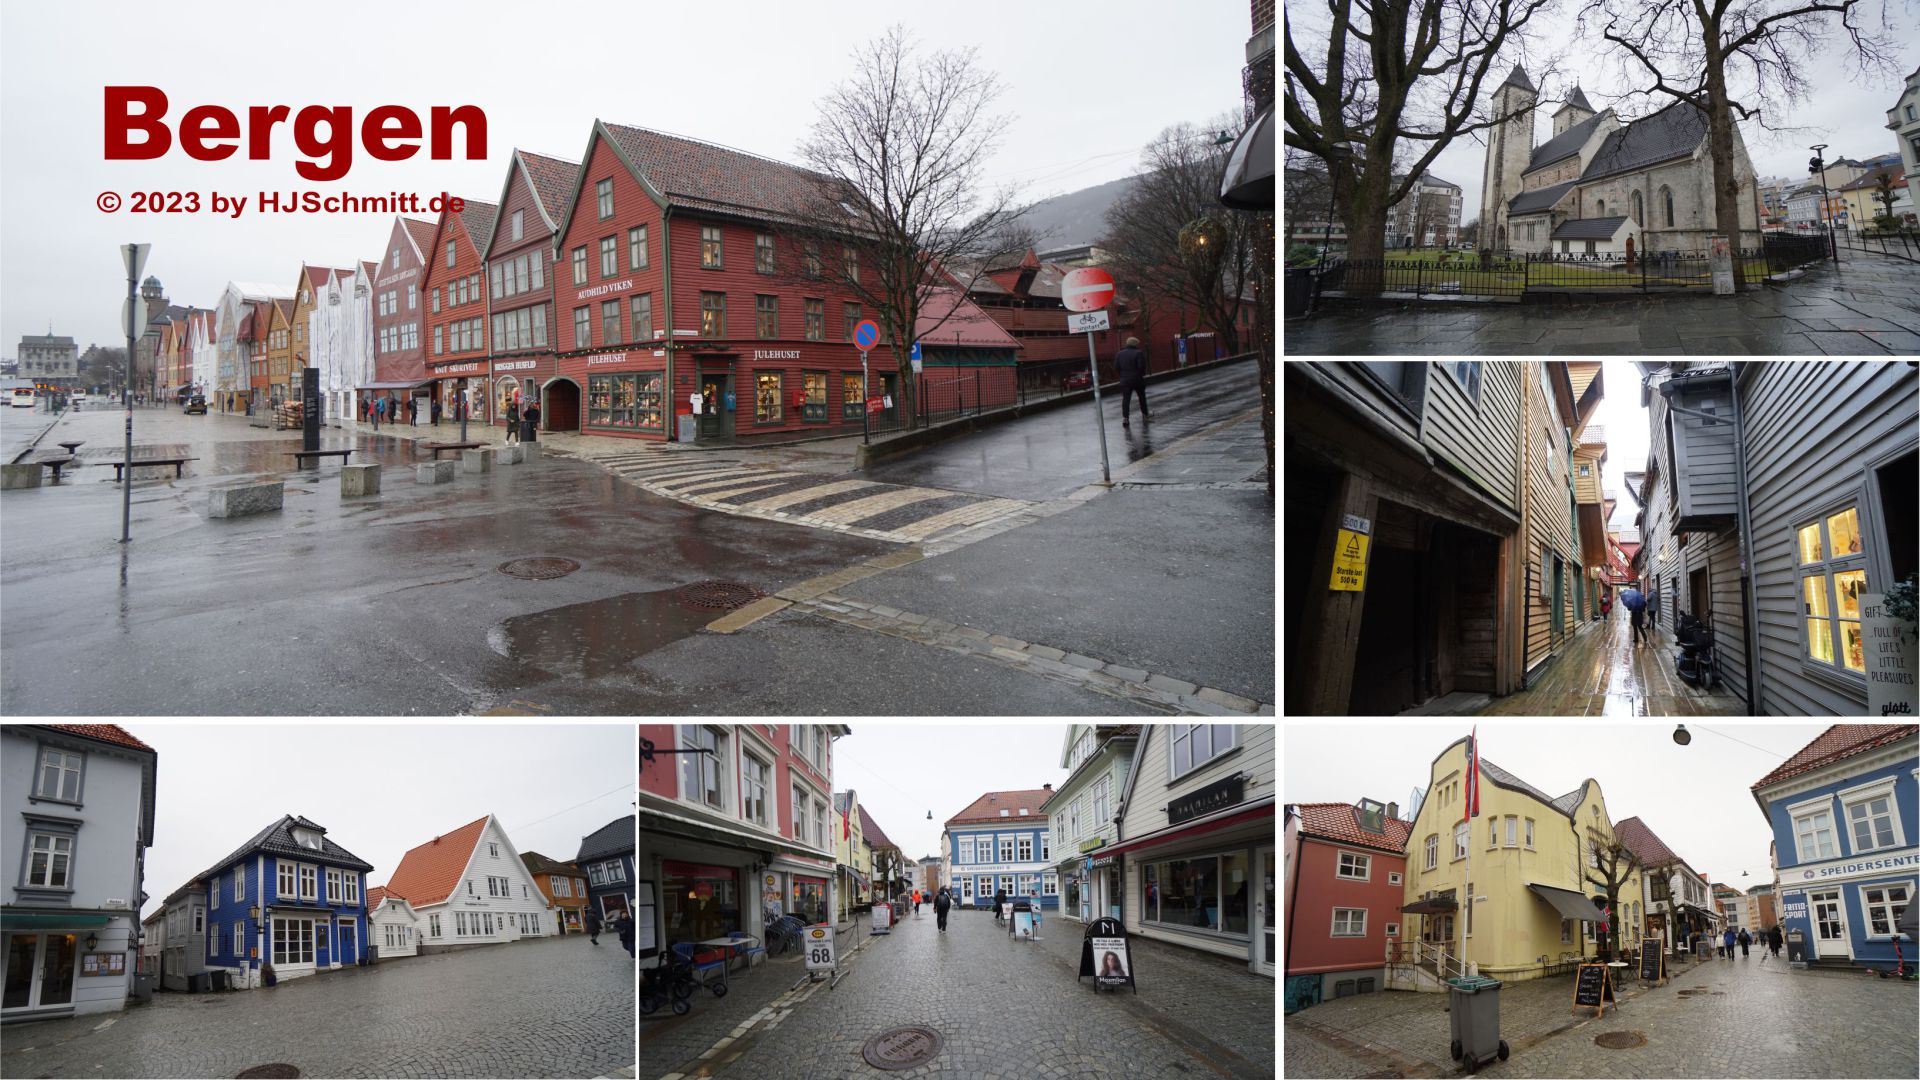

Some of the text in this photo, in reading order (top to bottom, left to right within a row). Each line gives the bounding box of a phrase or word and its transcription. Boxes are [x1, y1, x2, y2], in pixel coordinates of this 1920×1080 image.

[577, 279, 633, 300] AUDHILD VIKEN
[588, 353, 627, 367] JULEHUSET
[753, 350, 801, 361] JULEHUSET
[1343, 517, 1358, 528] 500
[1340, 576, 1351, 584] 500
[1864, 605, 1882, 618] GIFT
[1893, 626, 1901, 638] OF
[1879, 656, 1905, 669] LITTLE
[1871, 671, 1914, 685] PLEASURES
[1820, 854, 1918, 877] SPEIDERSENTE
[1784, 910, 1807, 919] SPORT
